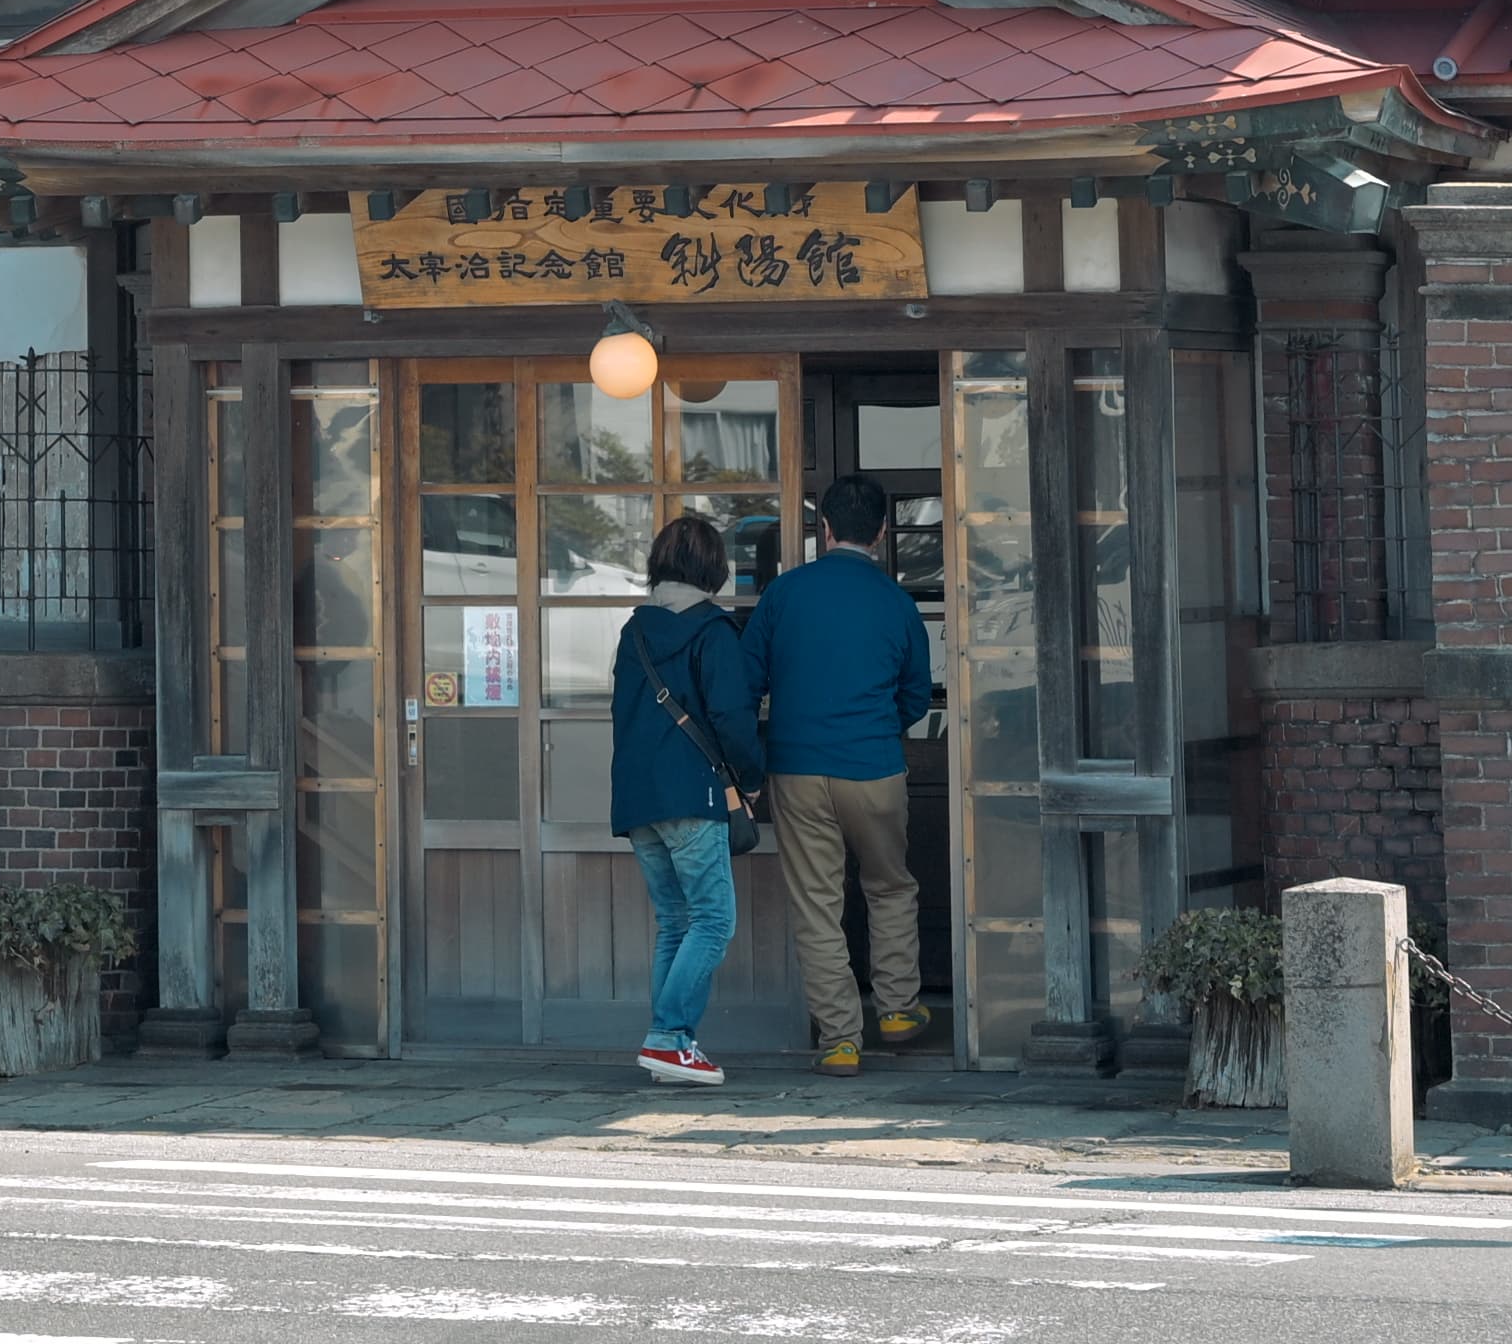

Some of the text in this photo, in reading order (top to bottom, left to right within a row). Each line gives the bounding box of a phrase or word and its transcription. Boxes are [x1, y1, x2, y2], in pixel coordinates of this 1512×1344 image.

[381, 247, 626, 286] 太宰治記念館
